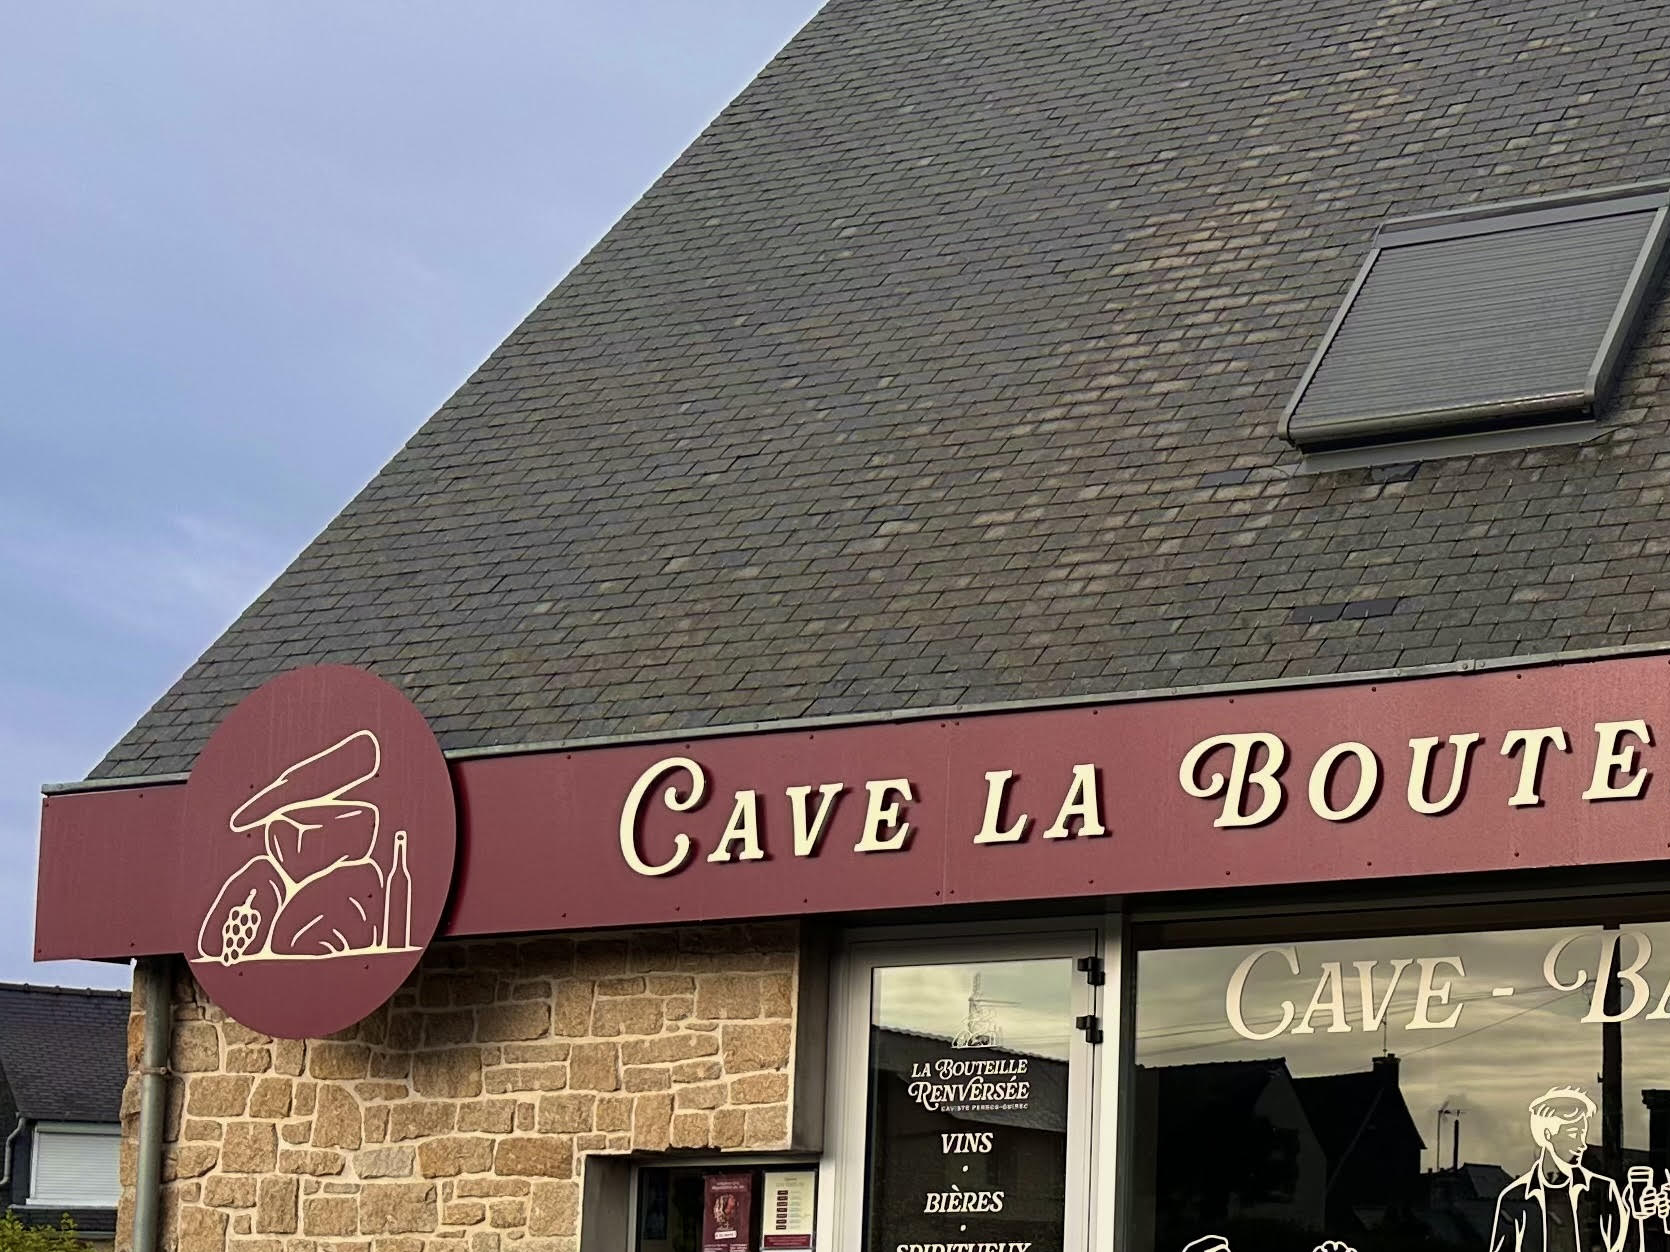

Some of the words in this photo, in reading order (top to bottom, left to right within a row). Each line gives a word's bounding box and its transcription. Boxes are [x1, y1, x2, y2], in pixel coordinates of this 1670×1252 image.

[620, 757, 913, 877] CAVE
[973, 763, 1106, 845] LA
[1226, 946, 1466, 1040] CAVE
[911, 1063, 931, 1078] LA
[935, 1059, 1028, 1080] BOUTEILLE
[908, 1075, 1030, 1111] RENVERSÉE
[941, 1133, 994, 1154] VINS
[924, 1184, 1005, 1213] BIÈRES
